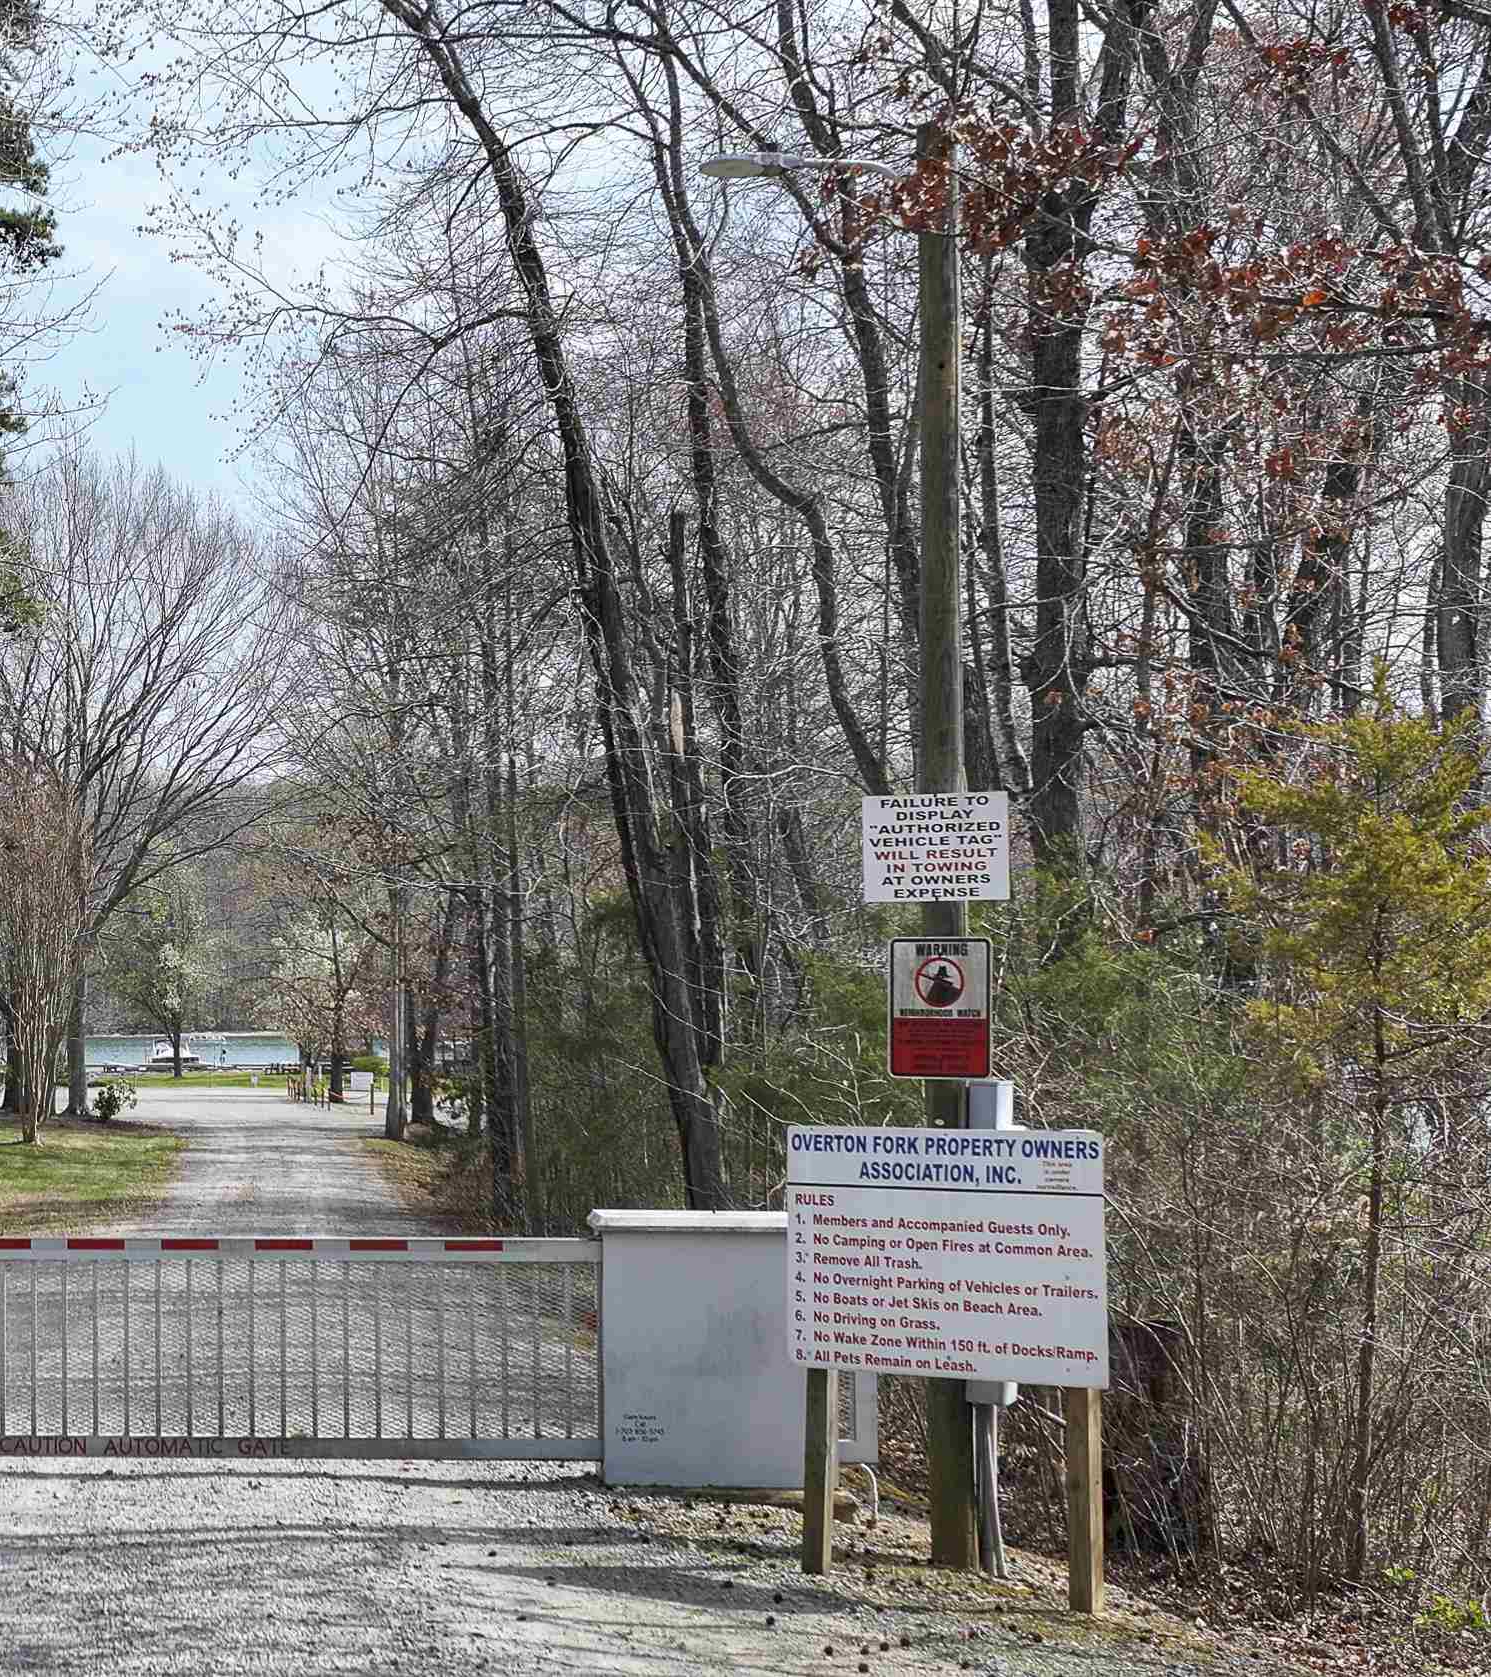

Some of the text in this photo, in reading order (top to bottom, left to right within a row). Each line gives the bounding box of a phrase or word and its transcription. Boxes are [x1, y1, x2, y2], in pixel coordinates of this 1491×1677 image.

[880, 795, 989, 809] FAILURE TO
[896, 809, 974, 821] DISPLAY
[870, 821, 1000, 834] "AUTHORIZED
[870, 834, 1002, 847] VEHICLE TAG"
[875, 847, 998, 861] WILL RESULT
[887, 861, 987, 873] IN TOWING
[882, 873, 991, 886] AT OWNERS
[894, 887, 980, 899] EXPENSE
[915, 943, 968, 956] WARNING
[791, 1133, 1099, 1159] OVERTON FORK PROPERTY OWNERS
[859, 1161, 1022, 1187] ASSOCIATION, INC.
[795, 1193, 835, 1206] RULES
[795, 1213, 1071, 1239] 1. Members and Accompanied Guests Only.
[795, 1232, 1093, 1258] 2. No Camping or Open Fires at Common Area.
[795, 1252, 923, 1269] 3. Remove All Trash.
[795, 1271, 1099, 1299] 4. No Overnight Parking of Vehicles or Trailers.
[795, 1291, 1043, 1316] 5. No Boats or Jet Skis on Beach Area.
[795, 1310, 941, 1330] 6. No Driving on Grass.
[795, 1329, 806, 1341] 7.
[813, 1331, 830, 1343] No
[833, 1331, 868, 1345] Wake
[871, 1334, 903, 1347] Zone
[905, 1336, 947, 1350] Within
[951, 1339, 974, 1352] 150
[977, 1341, 991, 1353] ft.
[995, 1343, 1009, 1354] of
[795, 1349, 977, 1372] 8. All Pets Remain on Leash.
[0, 1437, 294, 1455] CAUTION AUTOMATIC GATE
